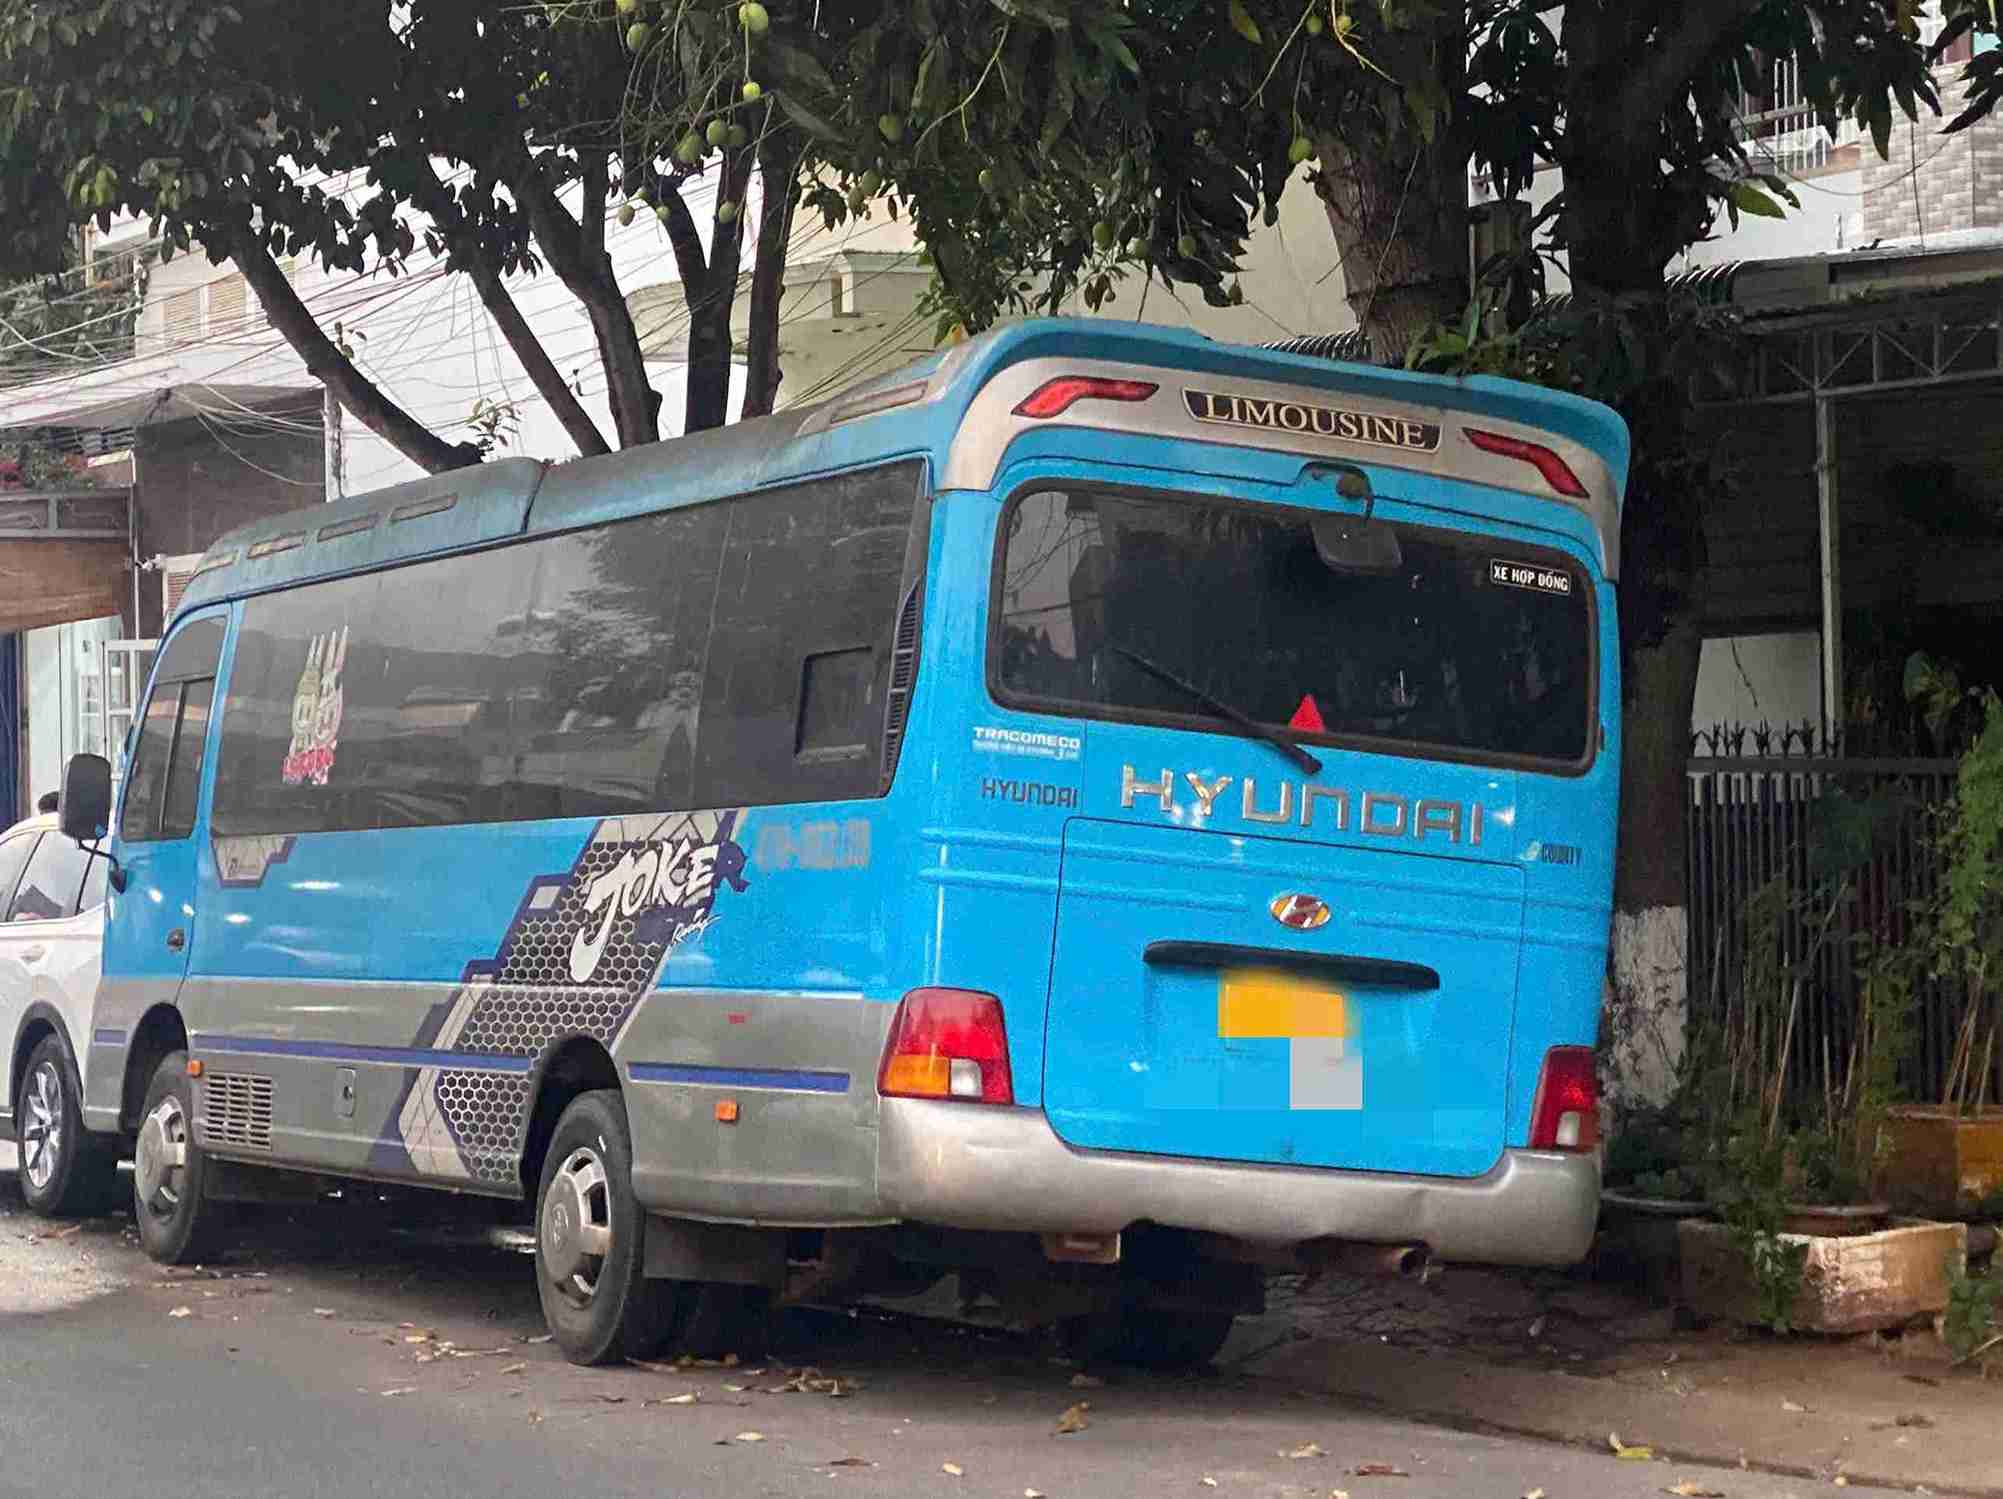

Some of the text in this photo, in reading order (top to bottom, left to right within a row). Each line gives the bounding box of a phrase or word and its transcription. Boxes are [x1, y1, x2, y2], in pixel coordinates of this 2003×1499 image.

[1205, 394, 1425, 448] LIMOUSINE
[1493, 564, 1509, 581] XE
[973, 727, 1081, 749] TRACOMECO
[980, 777, 1079, 809] HYUNDAI
[1120, 763, 1482, 847] HYUNDAI
